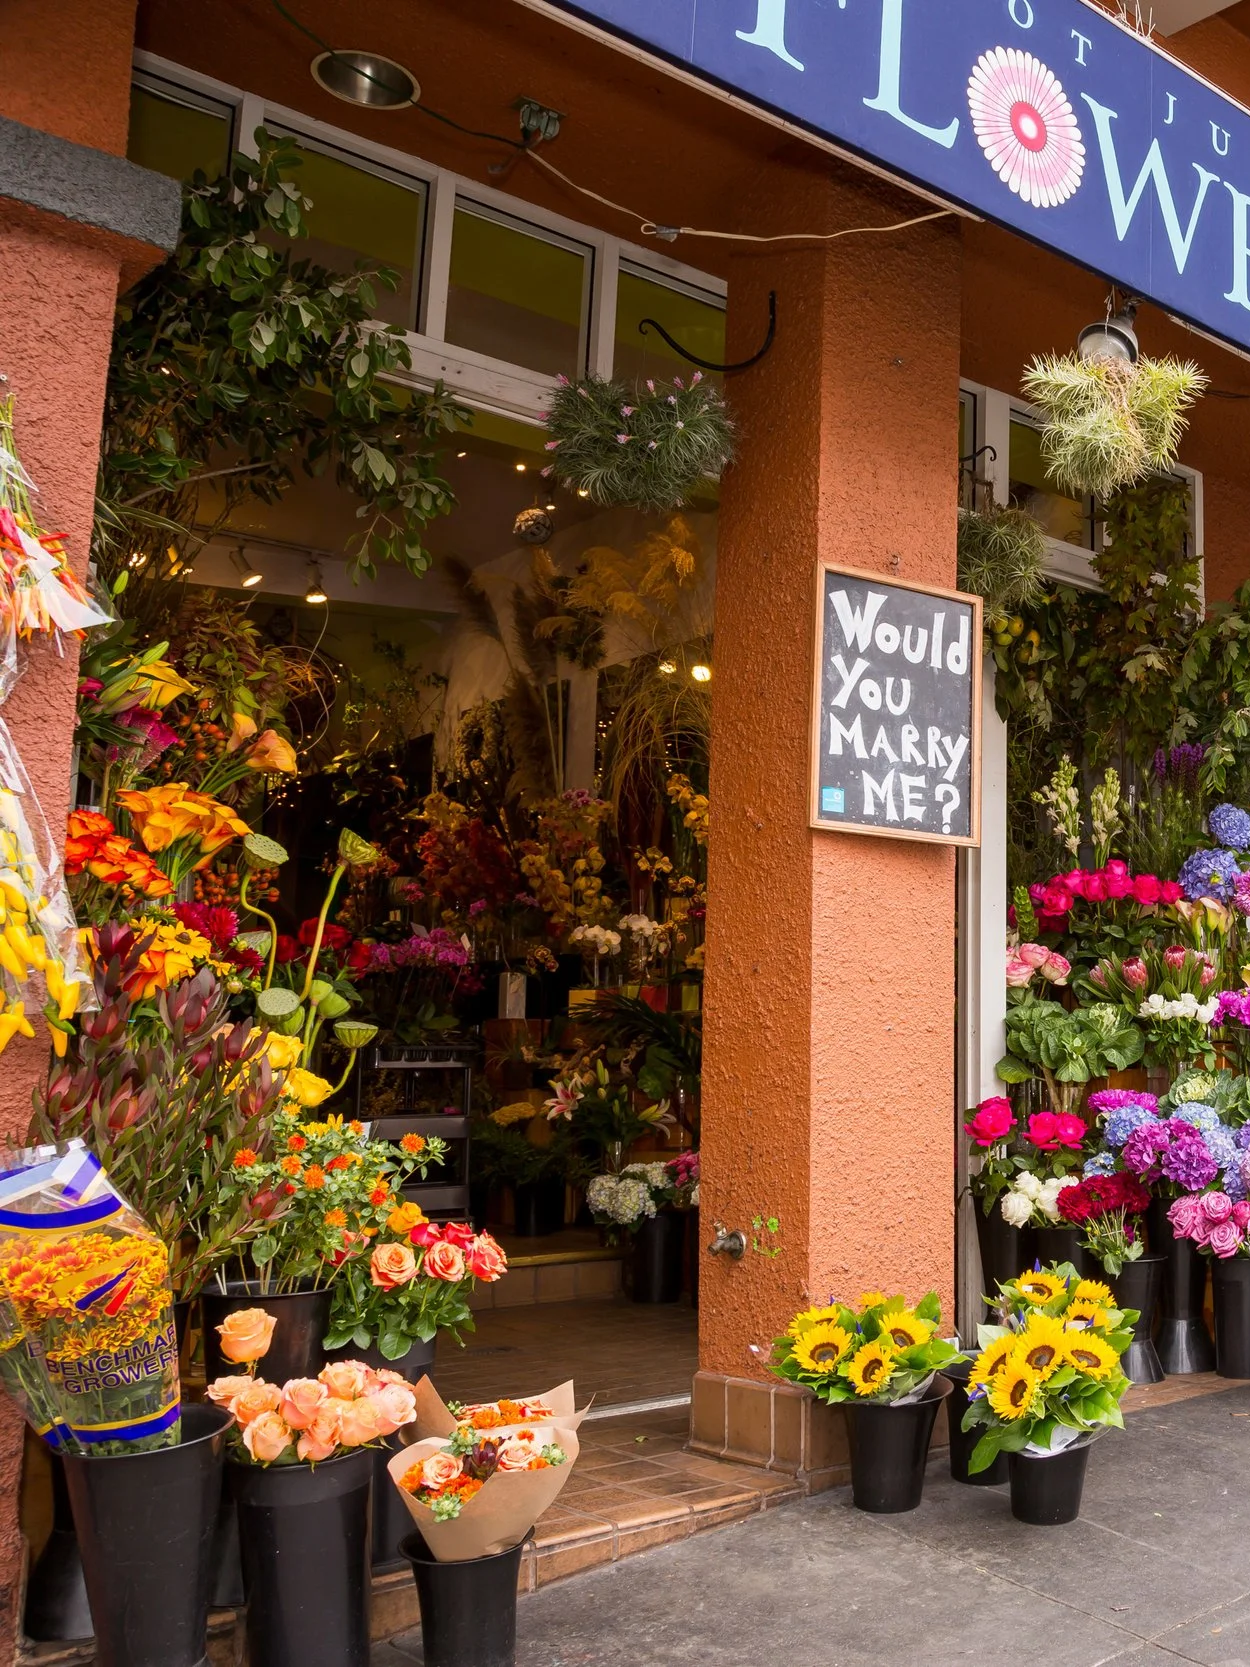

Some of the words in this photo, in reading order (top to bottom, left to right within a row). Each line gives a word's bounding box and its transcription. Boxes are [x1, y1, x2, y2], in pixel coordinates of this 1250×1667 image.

[1007, 0, 1093, 67] OT
[828, 589, 970, 675] Would
[861, 768, 961, 835] ME?
[45, 1323, 176, 1378] BENCHMAR
